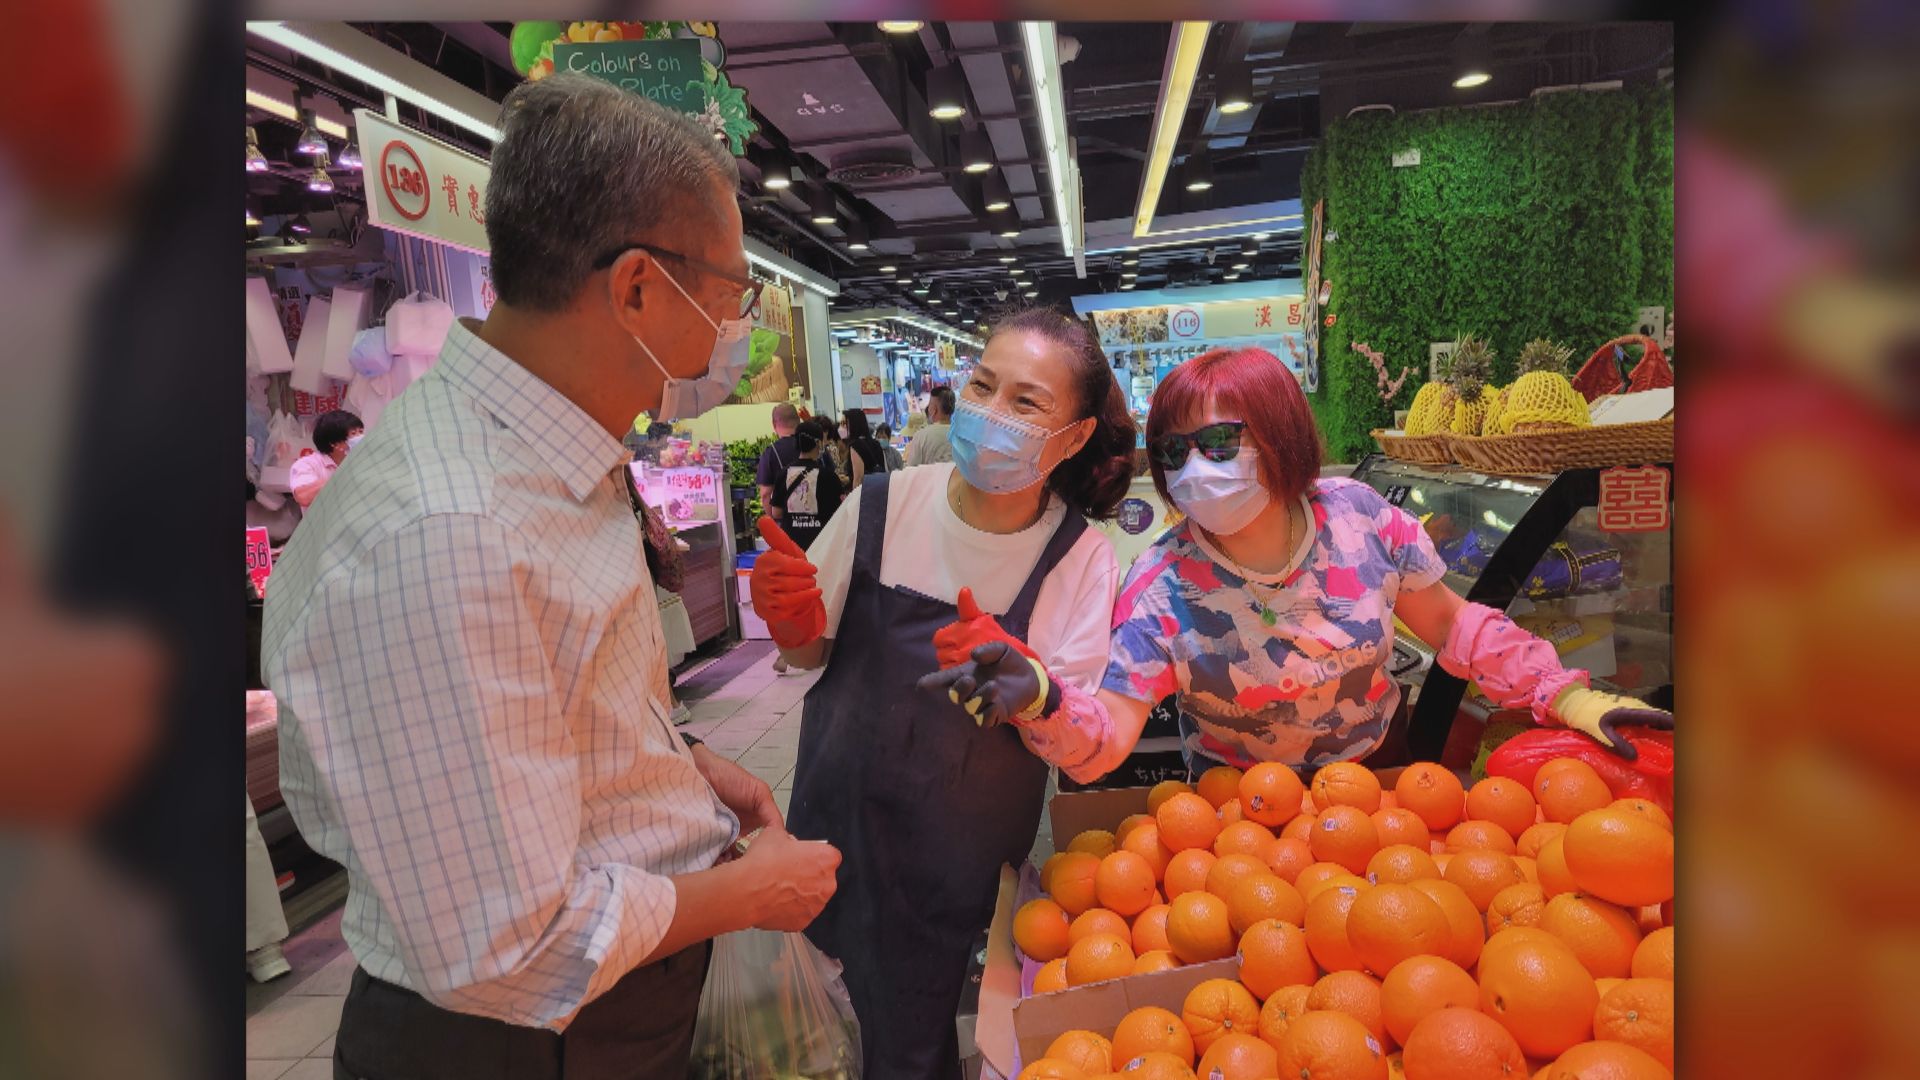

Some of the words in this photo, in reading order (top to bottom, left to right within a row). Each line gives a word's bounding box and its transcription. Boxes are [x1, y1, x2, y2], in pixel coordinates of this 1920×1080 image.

[568, 51, 651, 74] Colours
[657, 55, 681, 72] on
[387, 163, 423, 198] 136
[1177, 317, 1197, 329] 116
[1279, 639, 1378, 694] adidas
